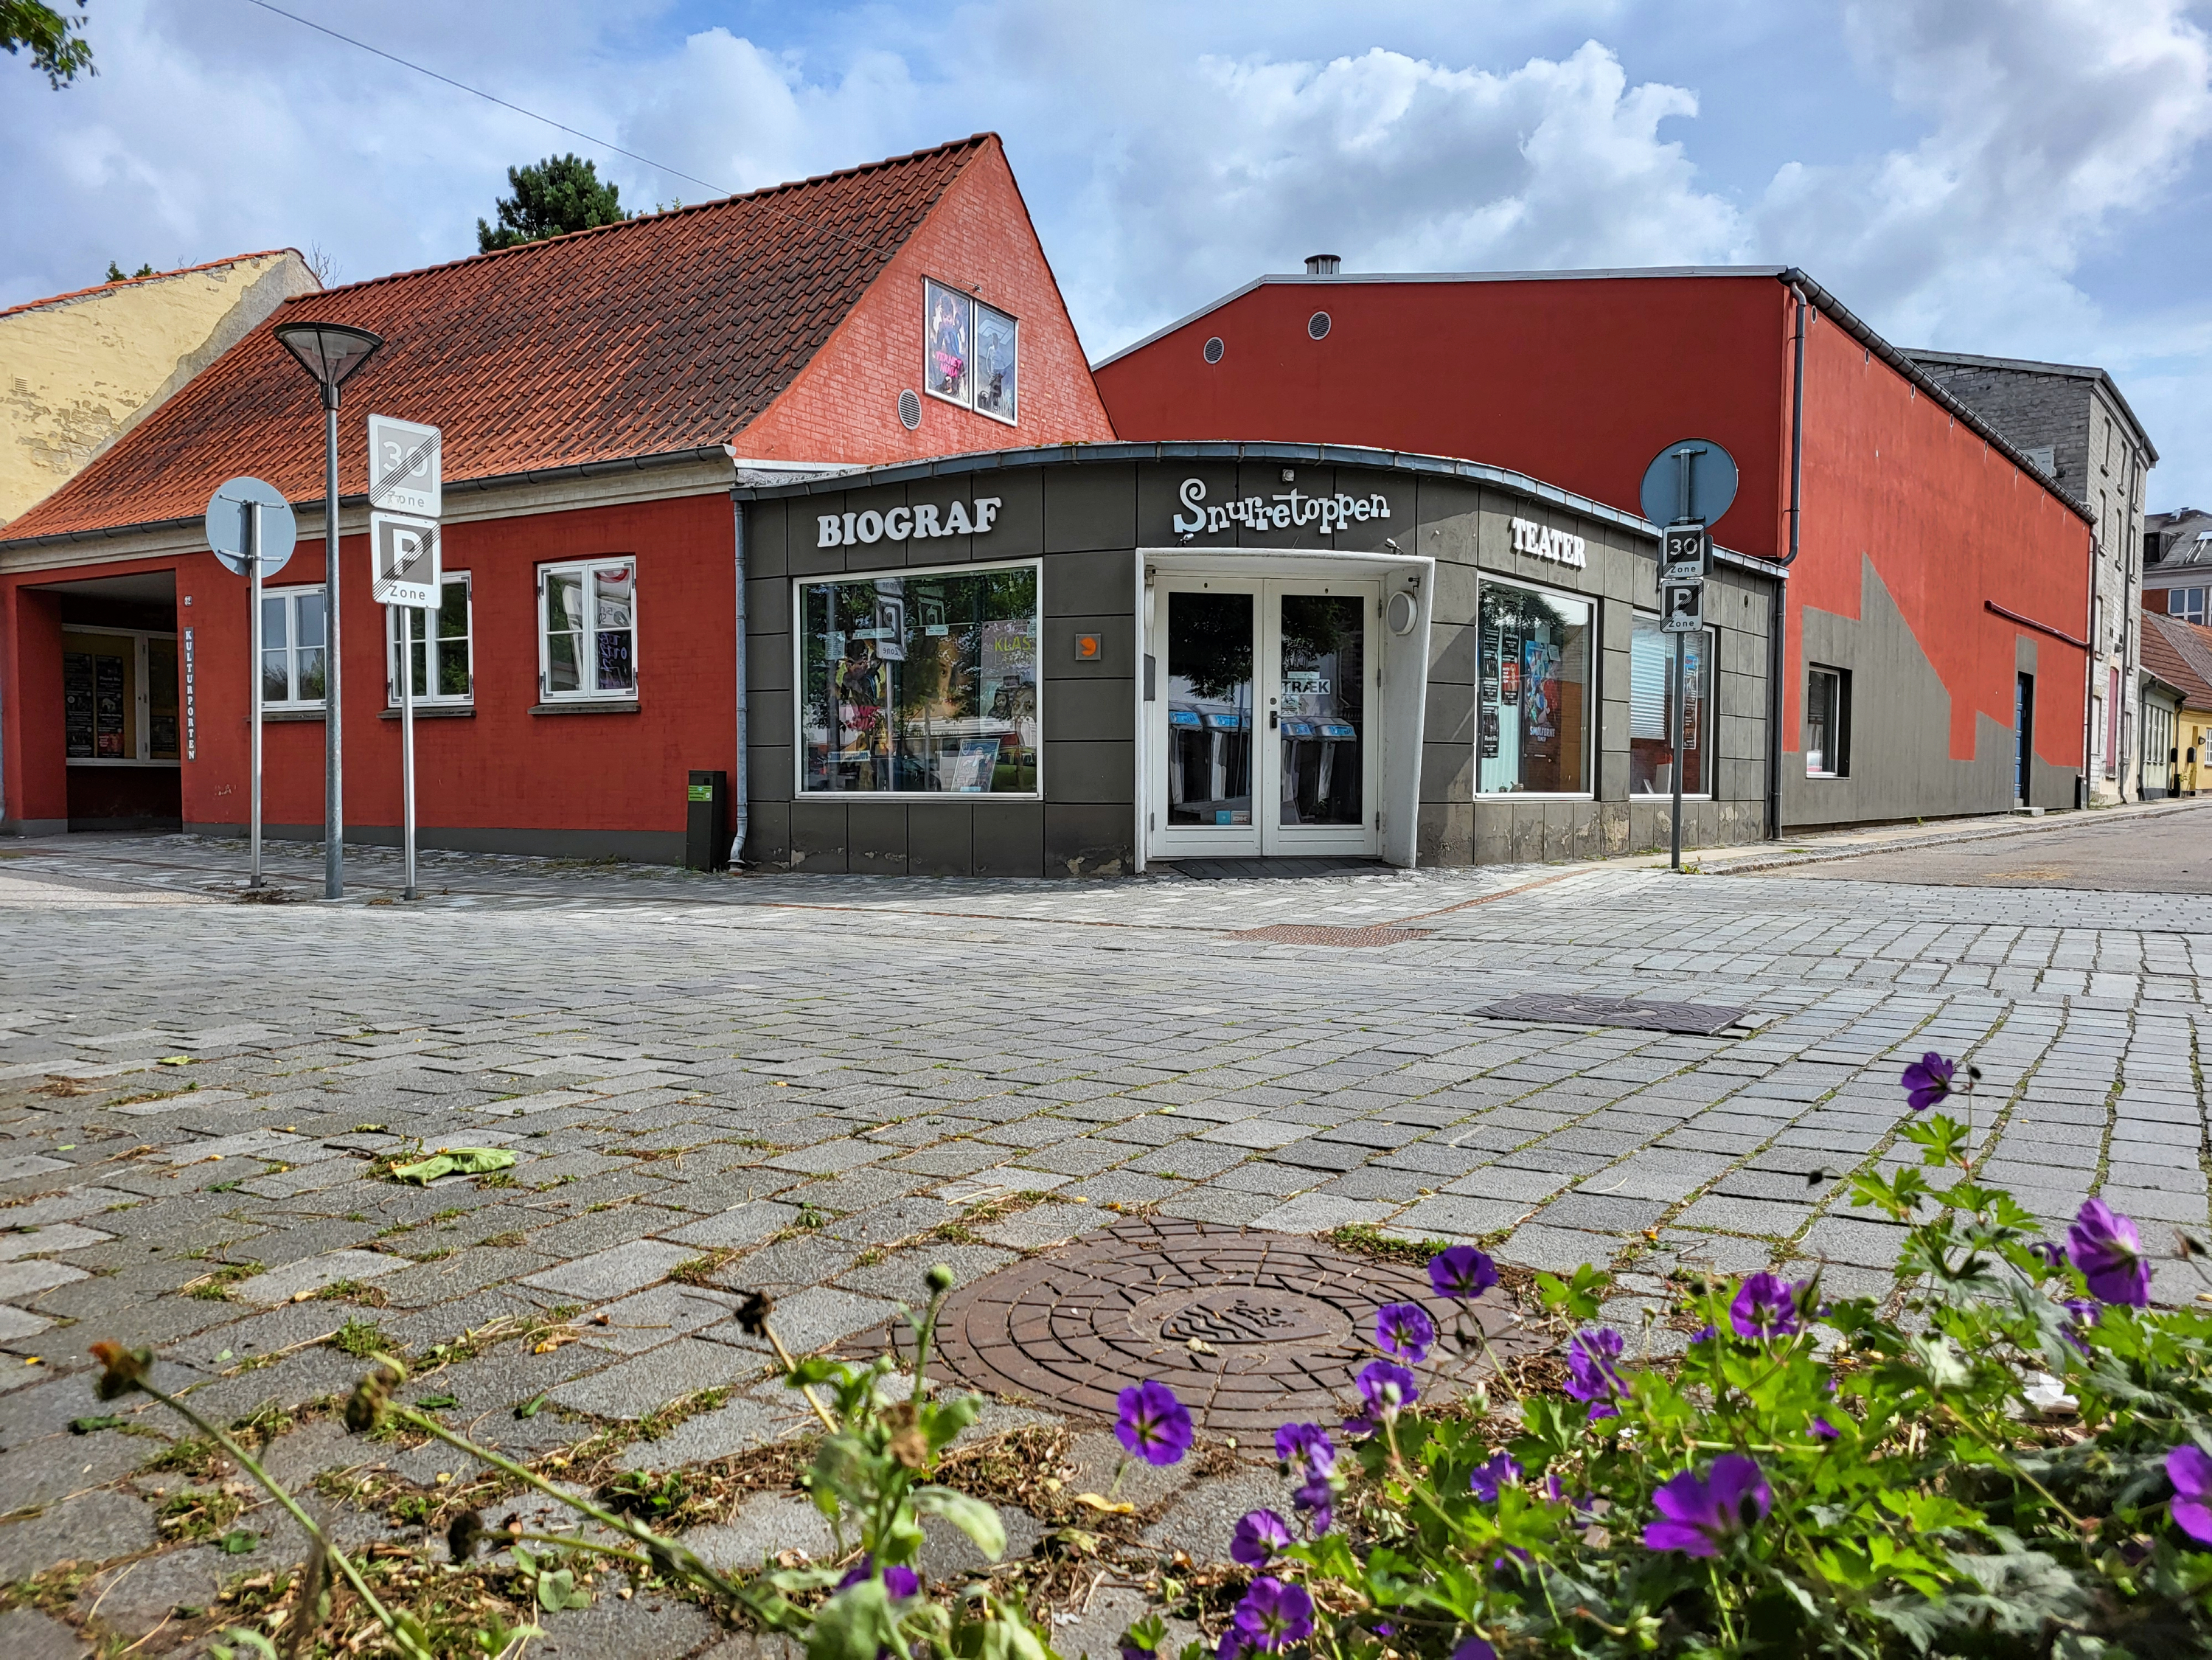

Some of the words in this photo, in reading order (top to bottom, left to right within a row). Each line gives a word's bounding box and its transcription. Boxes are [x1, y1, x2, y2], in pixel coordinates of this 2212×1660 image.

[936, 350, 962, 369] TERNET
[383, 441, 428, 477] 30
[1173, 478, 1391, 534] Snurretoppen
[817, 497, 1003, 548] BIOGRAF
[392, 528, 424, 576] P
[1512, 516, 1587, 568] TEATER
[1669, 538, 1698, 555] 30
[1670, 566, 1697, 574] Zone
[389, 586, 426, 600] Zone
[1673, 588, 1693, 611] P
[1669, 619, 1694, 628] Zone
[185, 631, 195, 760] KULTURPORTEN
[1281, 681, 1329, 693] TRÆK
